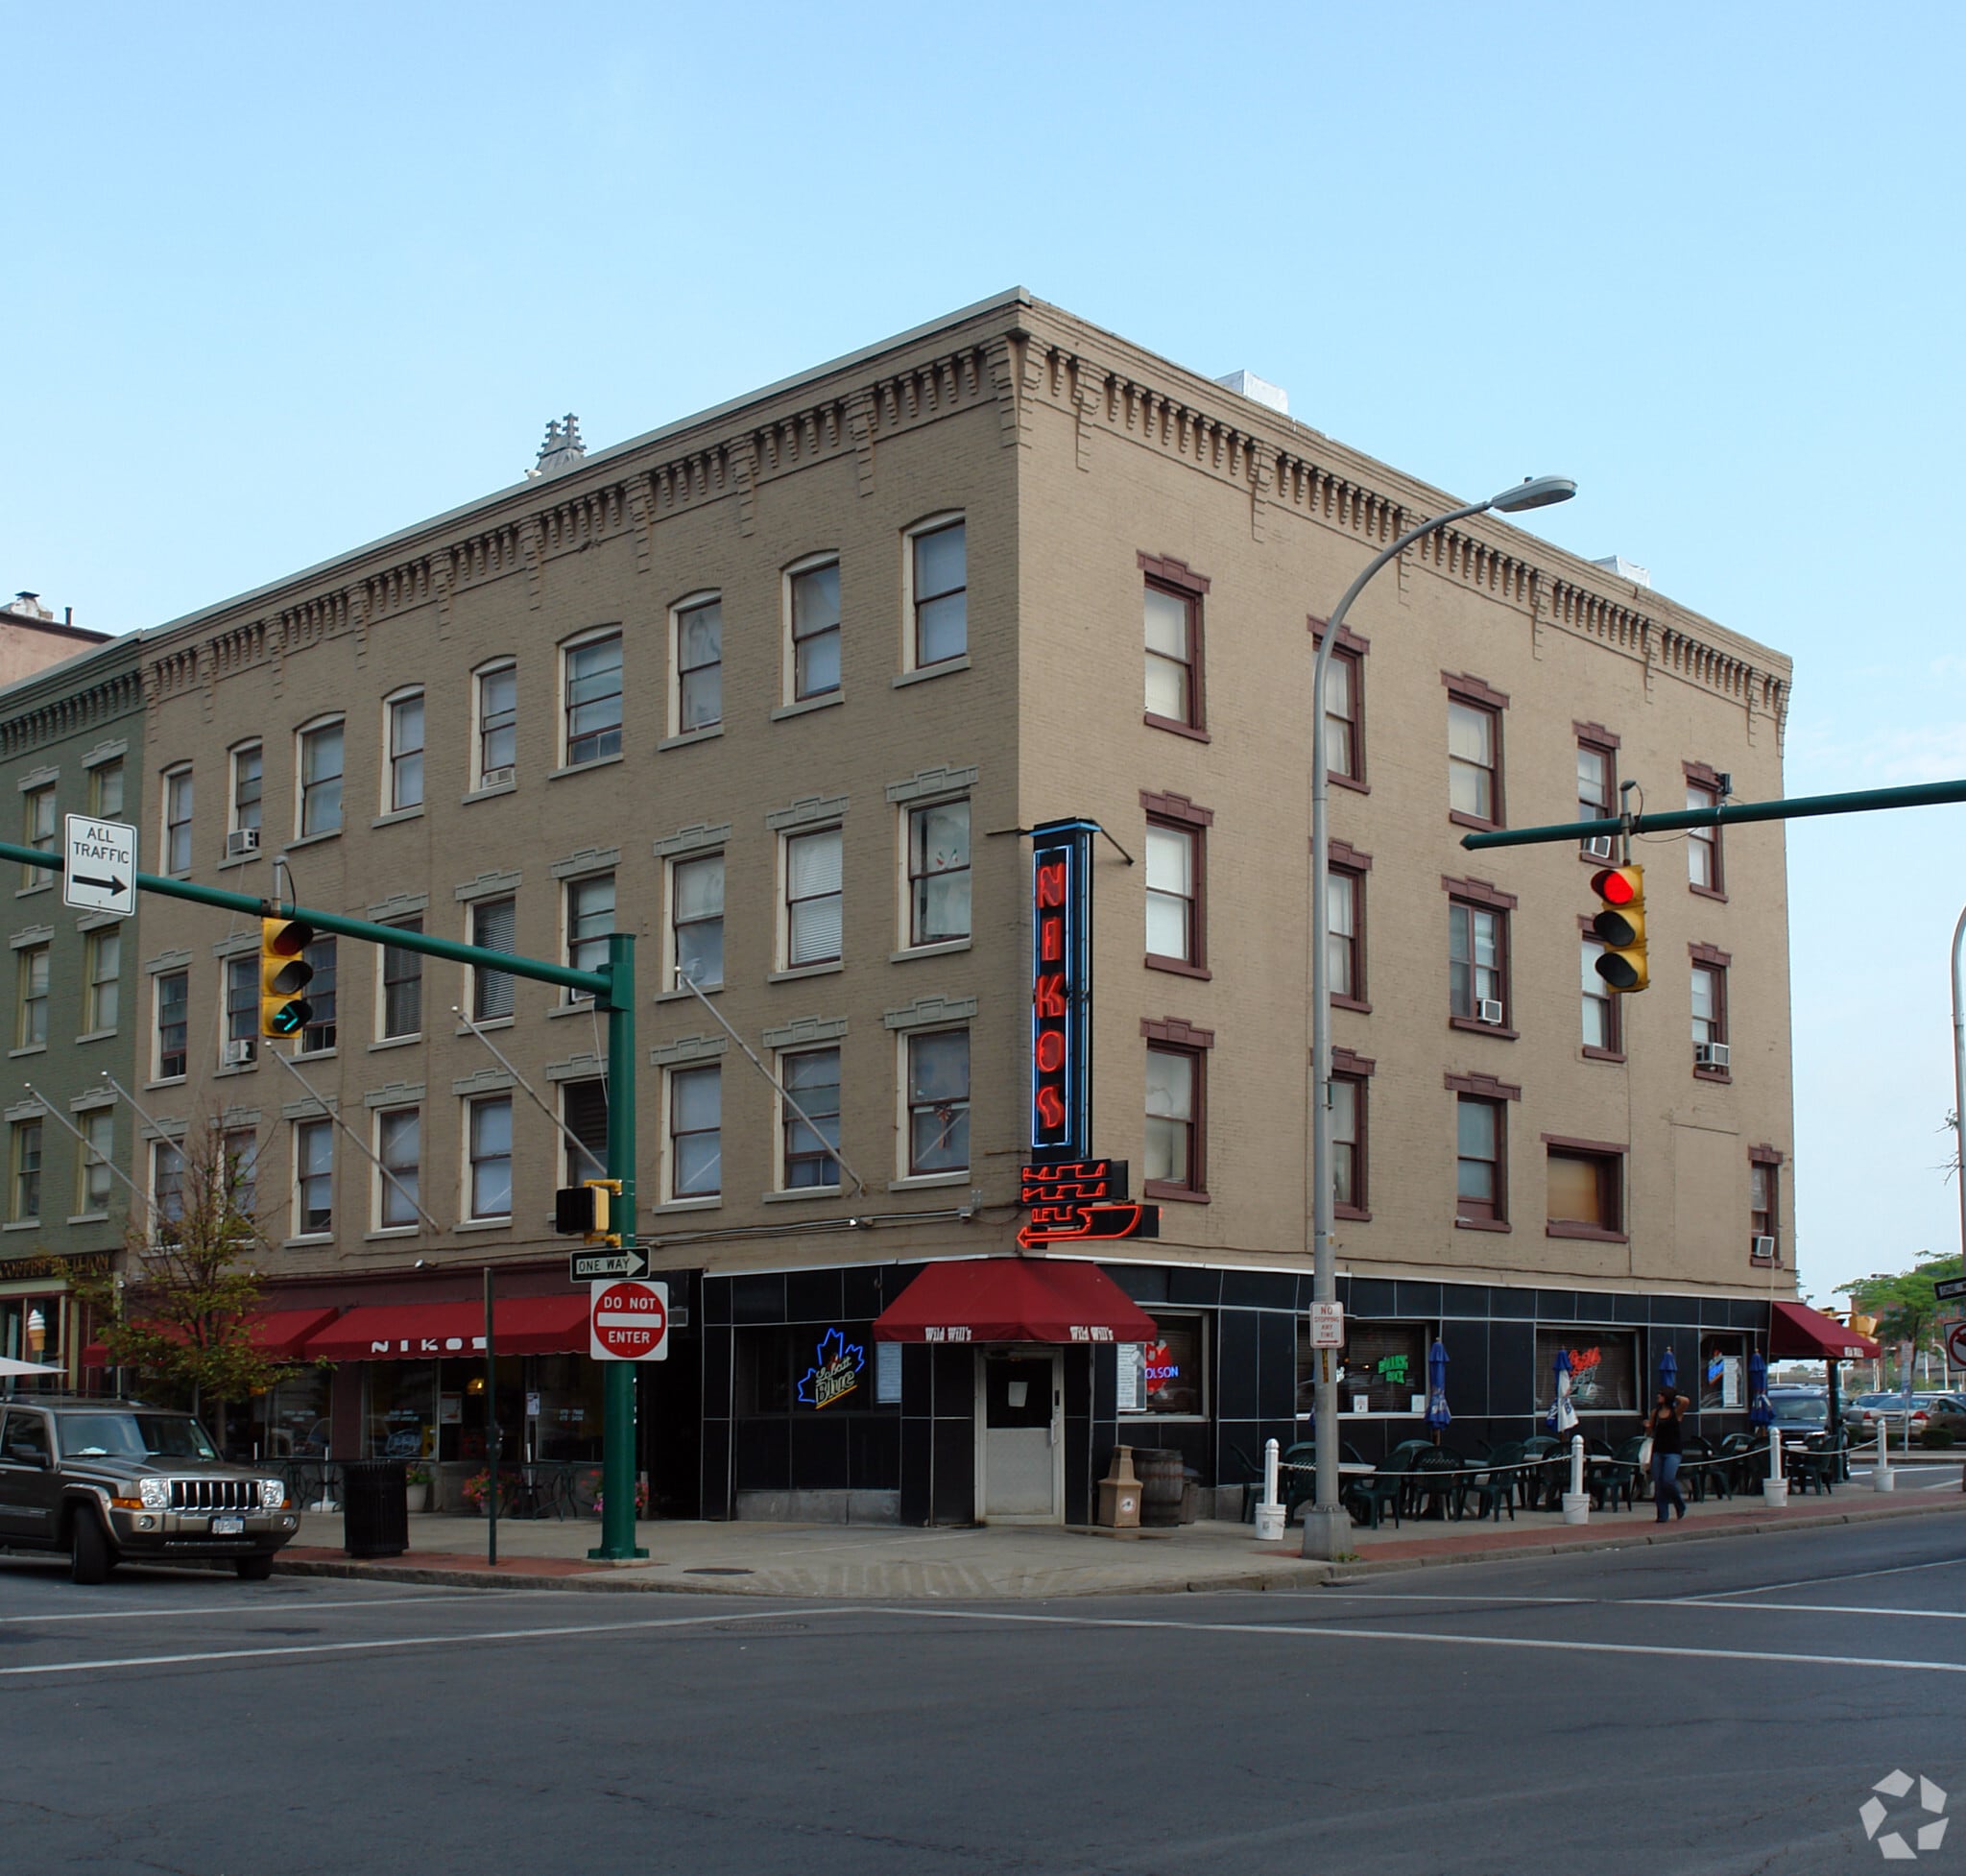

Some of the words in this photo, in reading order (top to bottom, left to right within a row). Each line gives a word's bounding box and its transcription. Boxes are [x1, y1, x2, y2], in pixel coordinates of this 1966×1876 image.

[87, 827, 114, 843] ALL
[73, 841, 130, 864] TRAFFIC
[1035, 862, 1066, 1129] NIKOS
[578, 1259, 600, 1272] ONE
[607, 1258, 630, 1270] WAY
[604, 1296, 622, 1309] DO
[629, 1297, 657, 1310] NOT
[1320, 1306, 1333, 1315] NO
[371, 1336, 487, 1353] NIKOS
[608, 1331, 650, 1344] ENTER
[1145, 1365, 1179, 1379] OLSON
[815, 1371, 855, 1406] Blue
